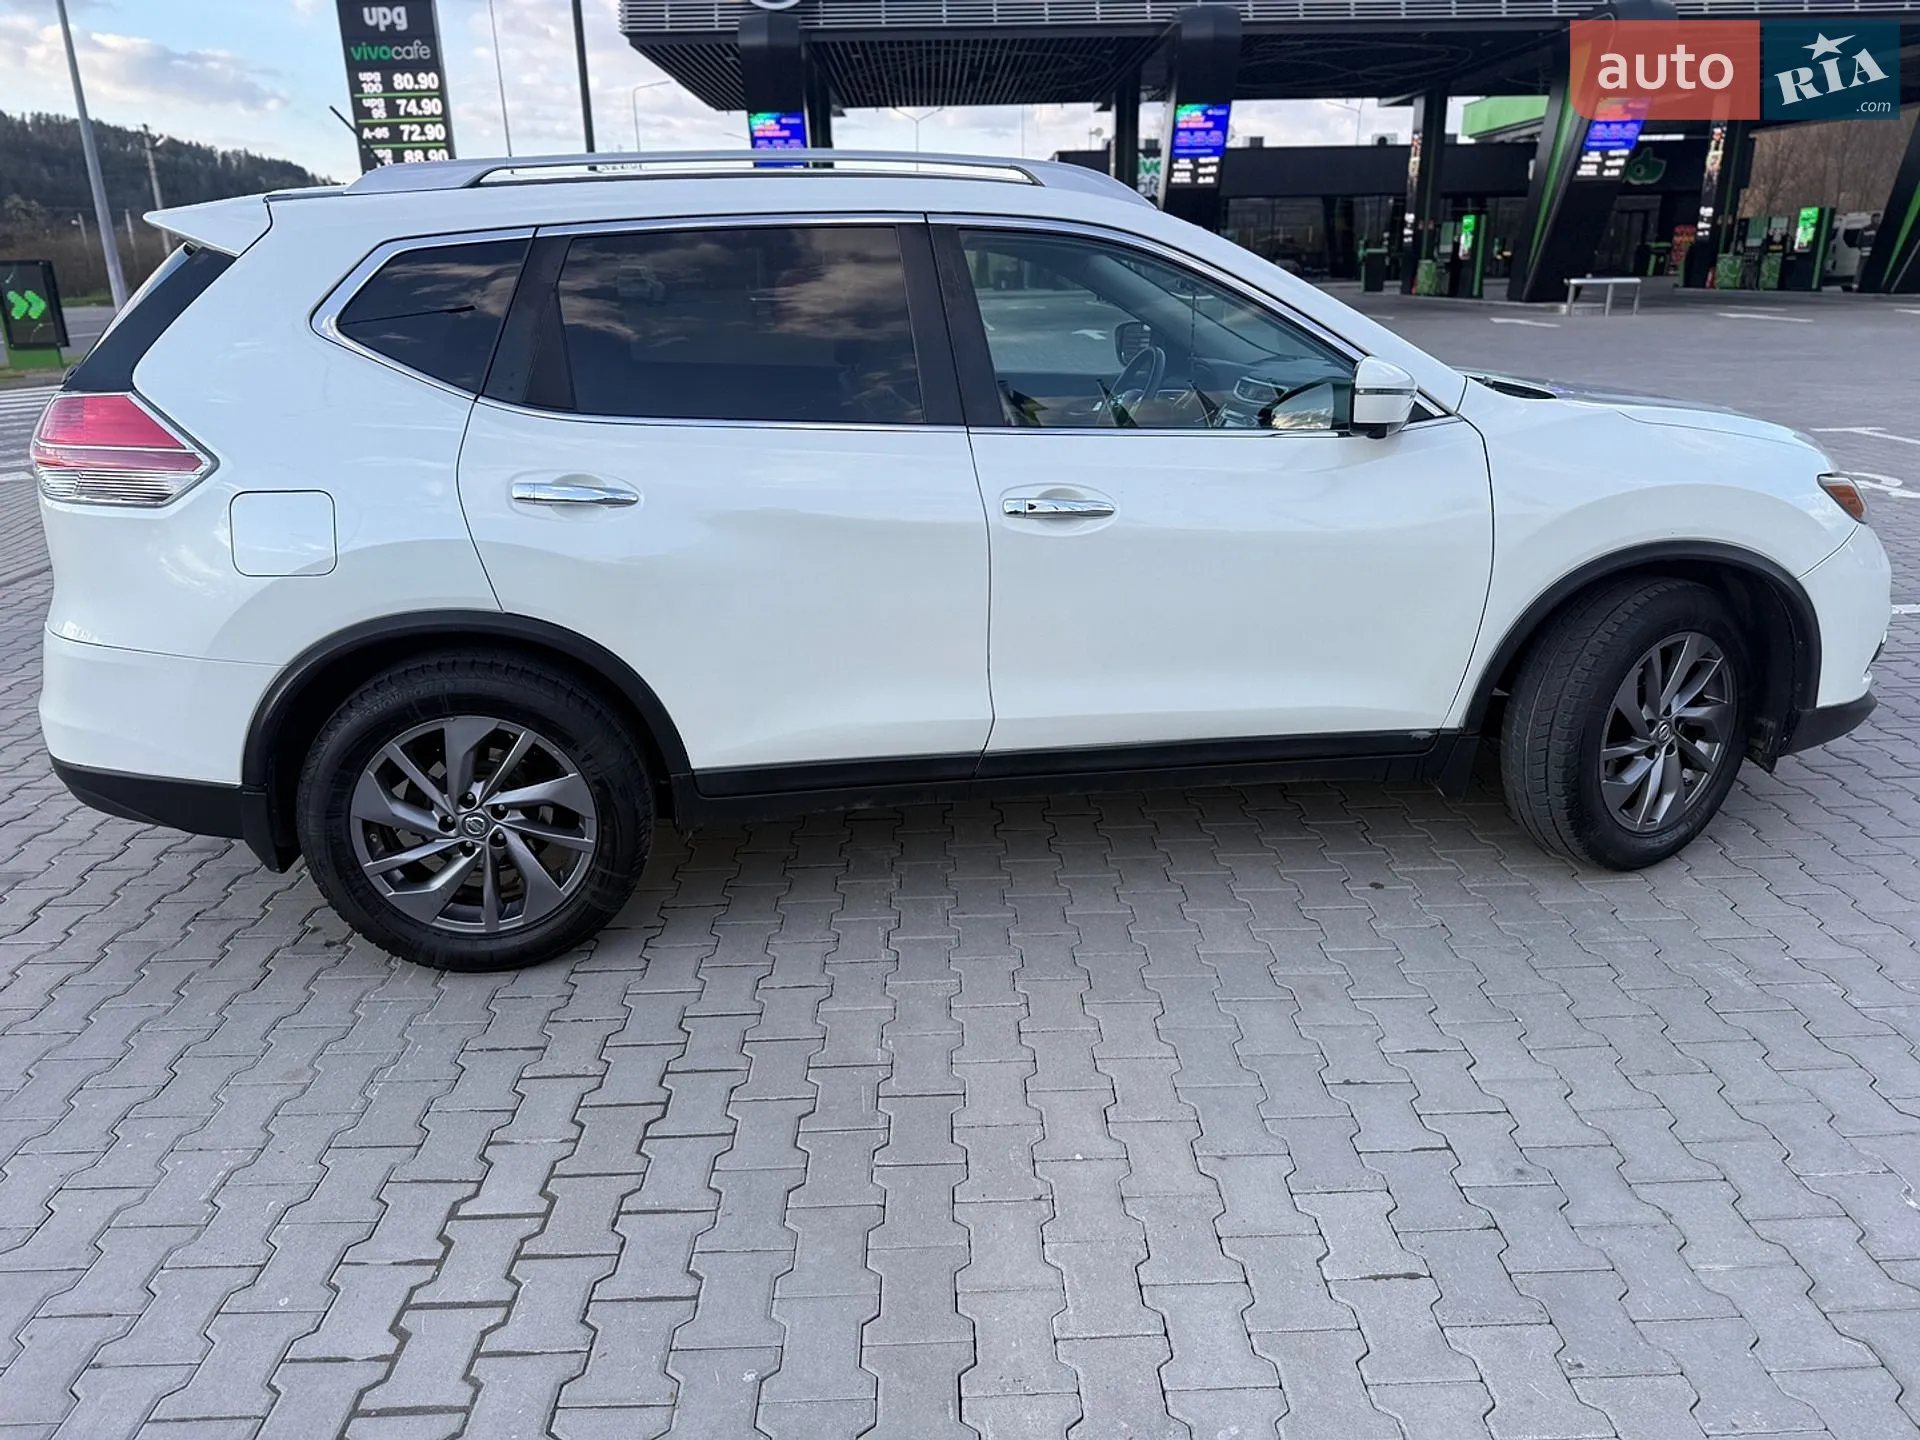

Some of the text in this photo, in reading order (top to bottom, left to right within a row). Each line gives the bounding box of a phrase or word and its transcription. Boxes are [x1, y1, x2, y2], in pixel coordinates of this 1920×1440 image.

[362, 5, 408, 31] upg
[350, 40, 431, 60] vivocafe
[358, 71, 381, 83] upg
[392, 72, 439, 90] 80.90
[361, 83, 383, 93] 100
[362, 98, 385, 108] upg
[396, 98, 443, 116] 74.90
[399, 124, 446, 141] 72.90
